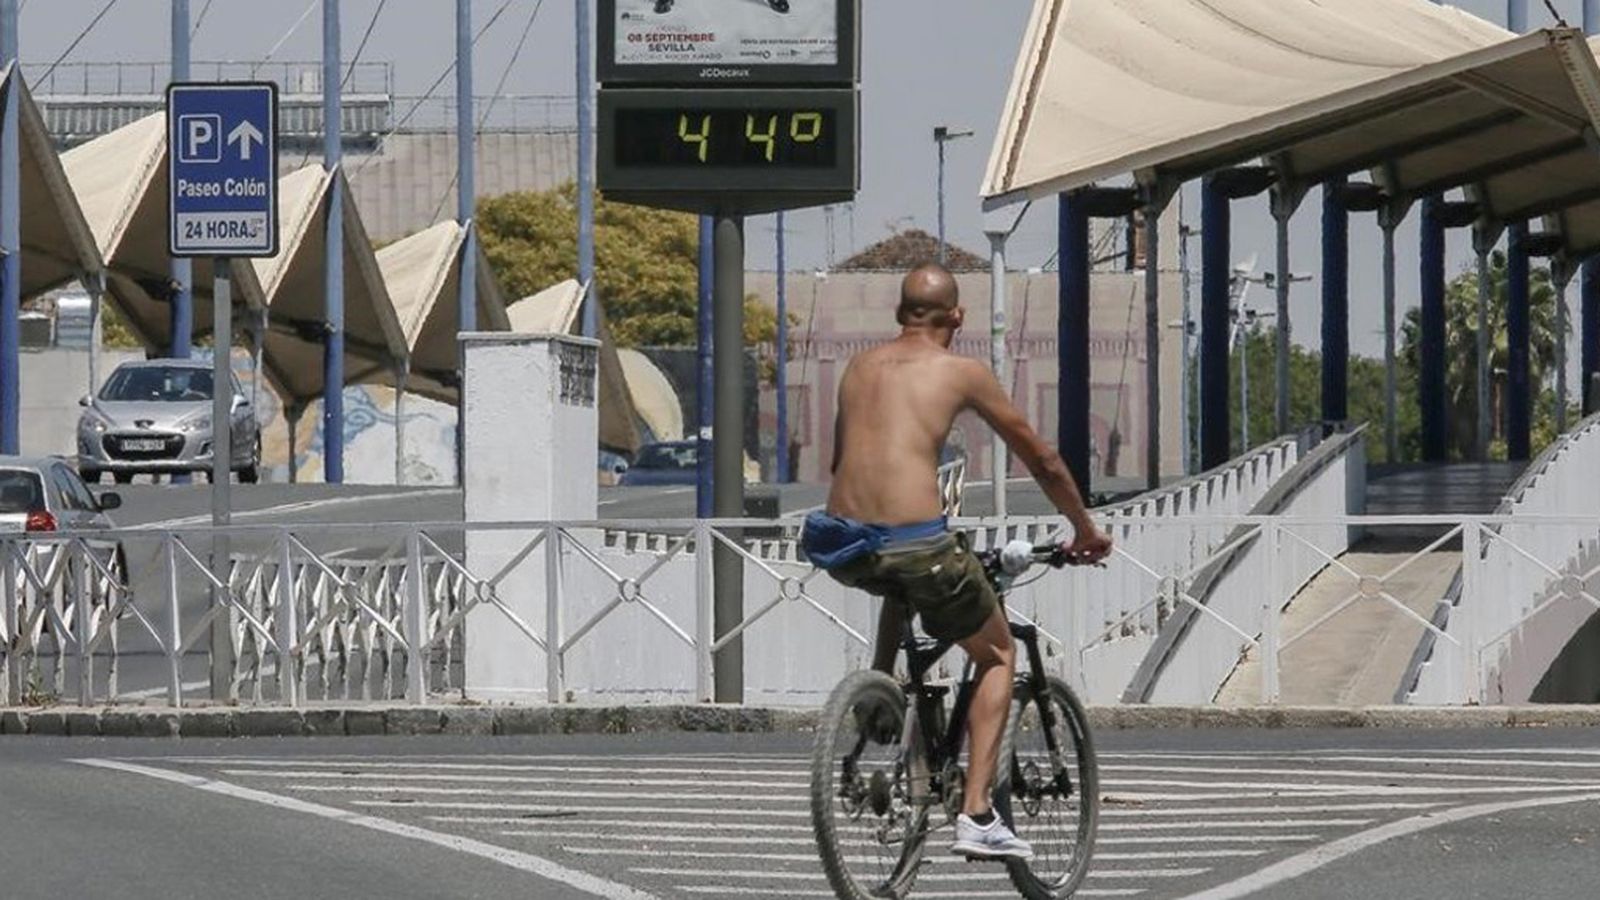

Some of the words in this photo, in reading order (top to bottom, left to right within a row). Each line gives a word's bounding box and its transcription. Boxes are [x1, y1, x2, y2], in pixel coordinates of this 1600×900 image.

[627, 33, 642, 42] 08
[645, 33, 715, 42] SEPTIEMBRE
[648, 43, 695, 52] SEVILLA
[699, 68, 750, 78] JCDecaux
[188, 120, 213, 156] P
[177, 178, 220, 197] Paseo
[224, 177, 266, 197] Colón
[184, 220, 203, 239] 24
